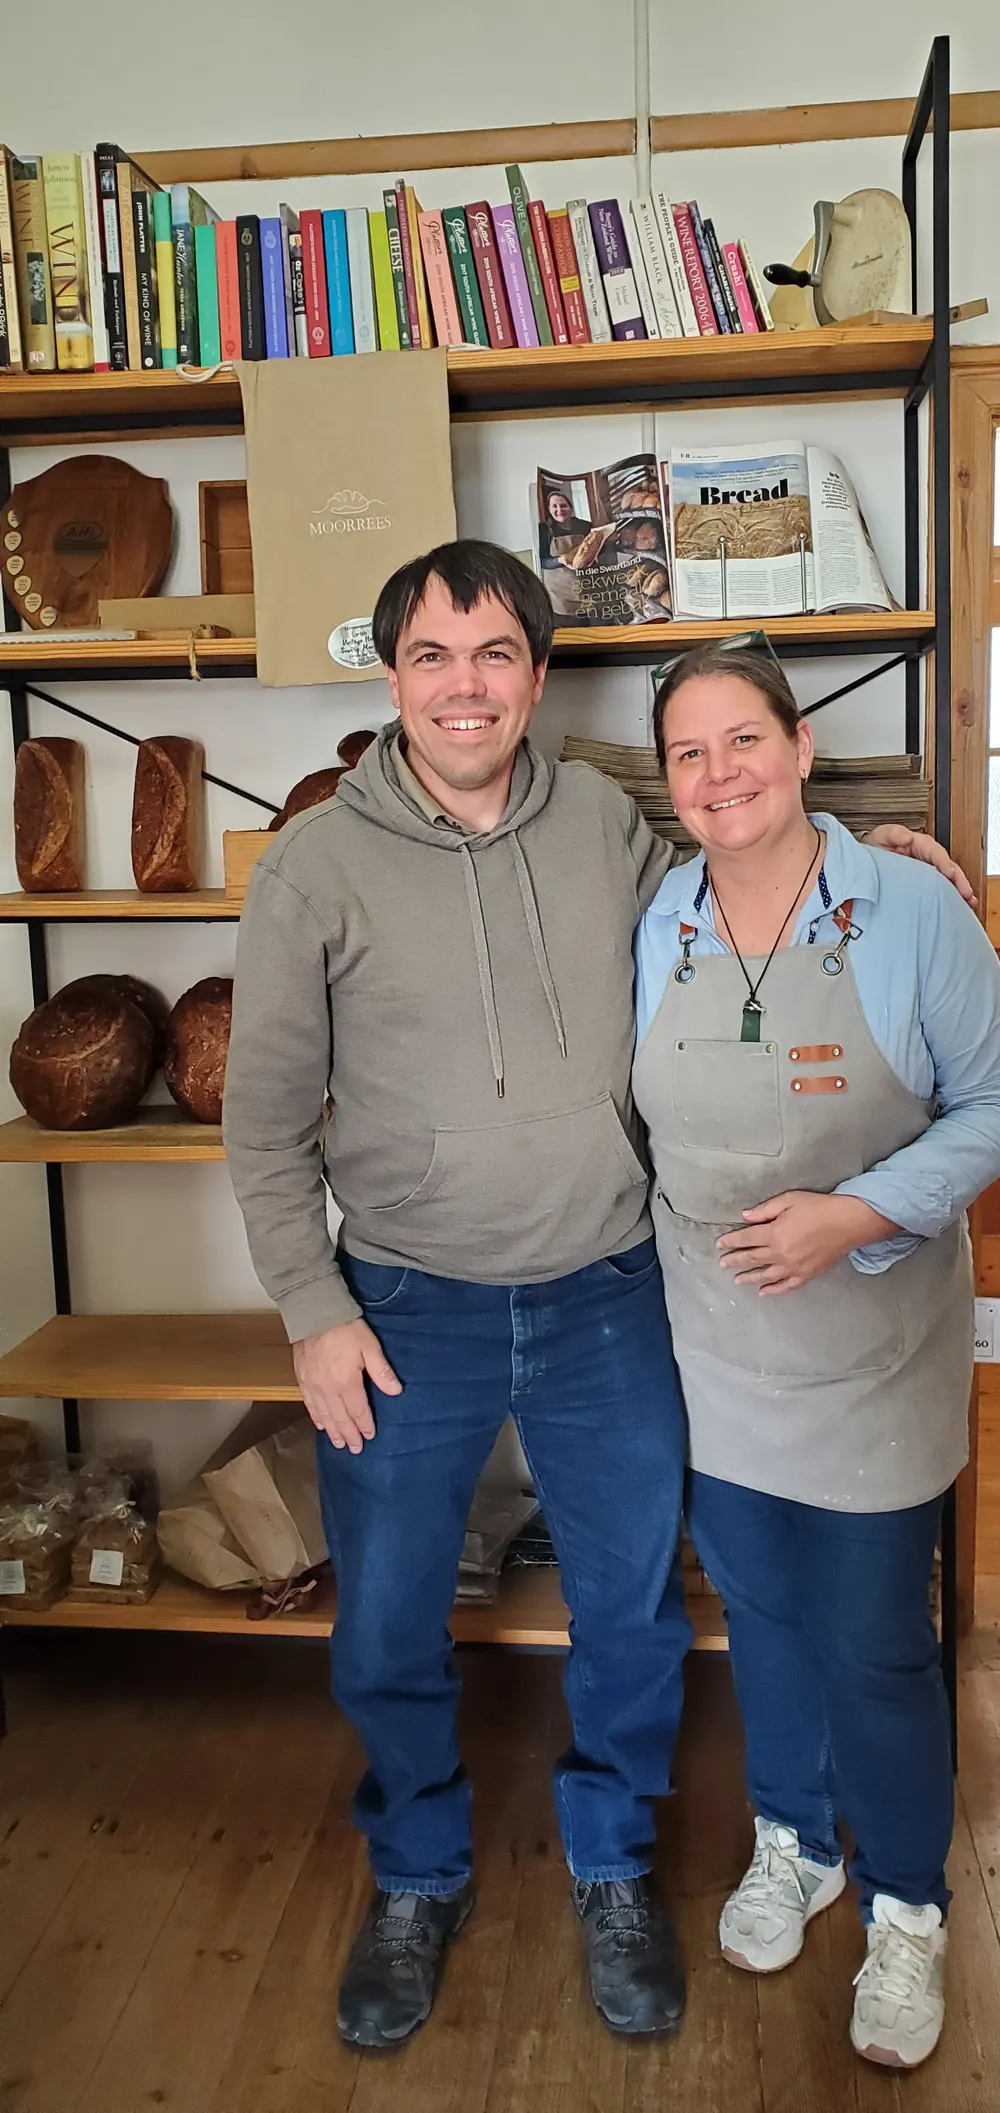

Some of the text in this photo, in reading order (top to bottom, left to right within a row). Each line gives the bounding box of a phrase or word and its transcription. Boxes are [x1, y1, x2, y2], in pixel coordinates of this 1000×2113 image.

[48, 164, 69, 173] Jancis
[16, 183, 34, 248] WINE
[135, 201, 143, 221] JOHN
[513, 186, 529, 237] OLIVE OIL
[603, 211, 615, 232] Buyer's
[597, 207, 615, 264] New Zealand Wines
[657, 192, 679, 265] THE PEOPLE'S GUIDE
[676, 215, 693, 247] WINE
[387, 227, 403, 273] CHEESE
[552, 223, 568, 276] COMPANION
[609, 232, 619, 249] Guide
[641, 214, 664, 284] WILLIAM BLACK
[175, 229, 188, 285] JANE Hunter
[613, 250, 619, 258] to
[702, 249, 713, 267] GUIDE
[50, 221, 80, 323] WINE
[295, 260, 301, 271] Oz
[683, 247, 704, 292] REPORT
[726, 250, 743, 287] Crush!
[295, 272, 304, 304] Clarke's
[462, 275, 470, 294] SOUTH
[485, 269, 494, 287] SOUTH
[717, 263, 736, 312] CHAMPAGNE
[465, 294, 475, 316] AFRICAN
[488, 287, 498, 309] AFRICAN
[613, 287, 623, 306] Cooper
[620, 285, 630, 305] Michael
[694, 292, 710, 320] 2006
[139, 272, 152, 346] MY KIND OF WINE
[493, 310, 501, 325] WINE
[591, 299, 599, 317] TERMS
[469, 317, 477, 331] WINE
[496, 324, 504, 341] GUIDE
[472, 331, 480, 346] GUID
[700, 478, 789, 505] Bread
[309, 516, 392, 536] MOORREES
[575, 556, 642, 577] In die Swartland
[580, 580, 642, 608] gemaal
[575, 596, 649, 620] en gebak
[975, 1340, 989, 1348] 60
